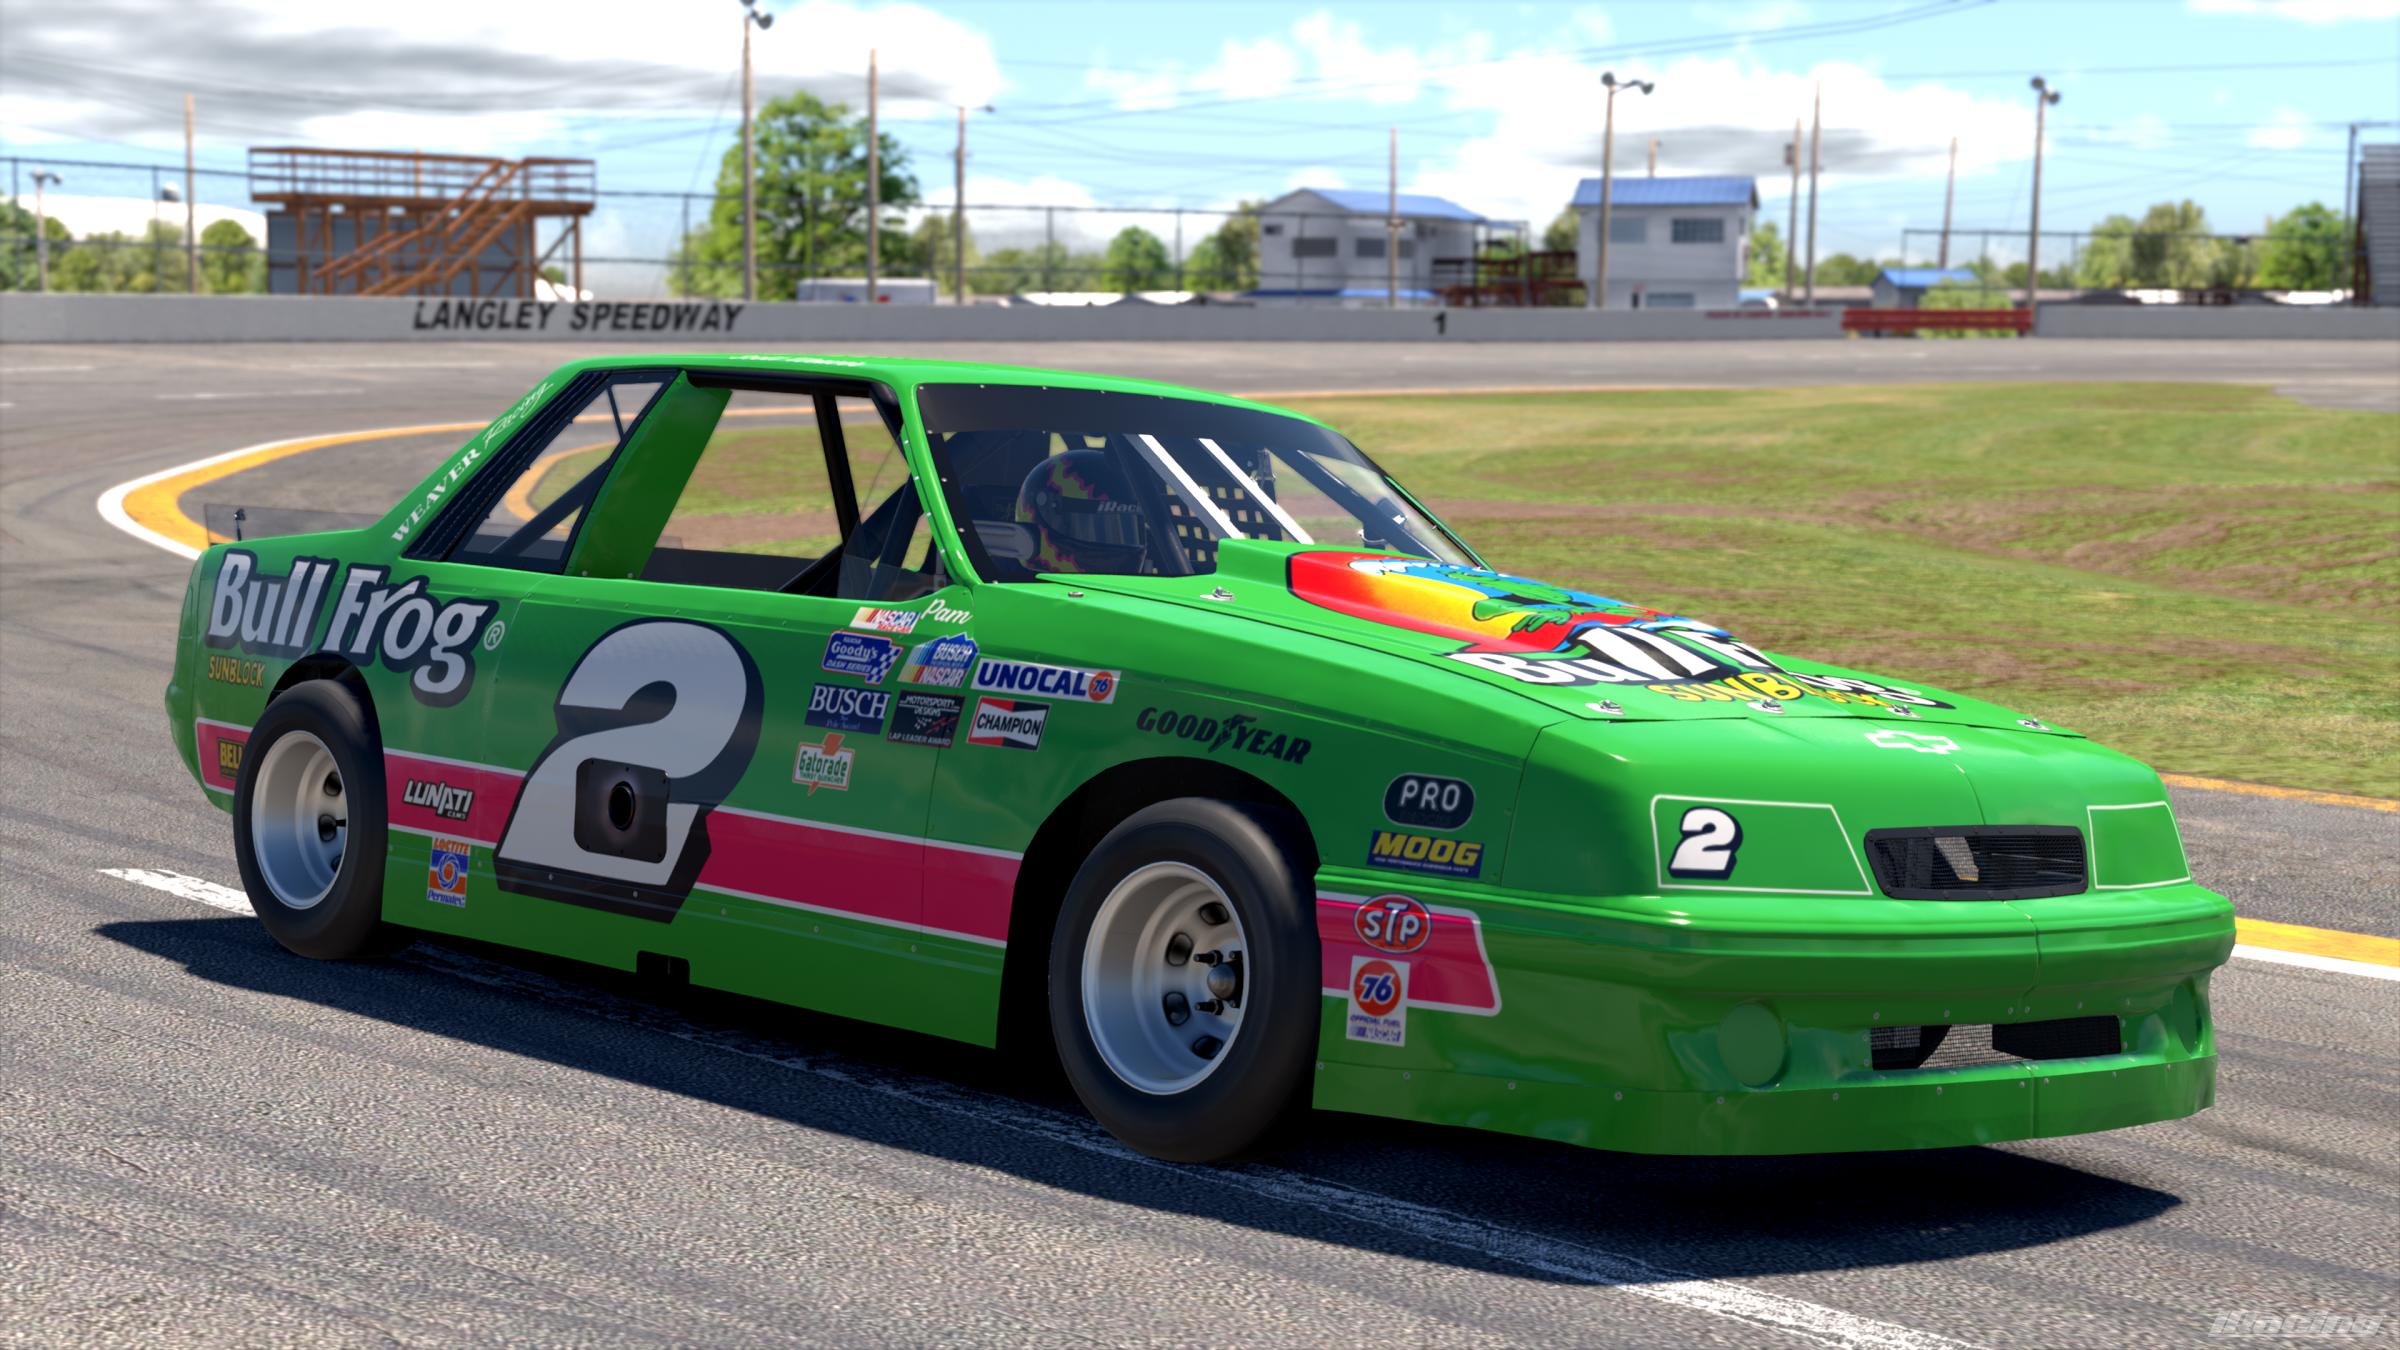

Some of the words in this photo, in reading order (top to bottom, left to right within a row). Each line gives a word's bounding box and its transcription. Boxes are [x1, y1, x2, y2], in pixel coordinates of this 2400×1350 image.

[413, 301, 556, 330] LANGLEY
[569, 302, 744, 332] SPEEDWAY
[1433, 311, 1447, 336] 1
[391, 448, 481, 541] WEAVER
[207, 551, 334, 650] Bull
[319, 566, 490, 695] Frog
[873, 608, 918, 628] NASCAR
[919, 598, 974, 625] Pam
[830, 640, 880, 663] Goody's
[932, 642, 973, 664] BUSCH
[207, 655, 266, 689] SUNBLOCK
[919, 665, 967, 689] NASCAR
[977, 662, 1087, 697] UNOCAL
[1092, 677, 1110, 694] 76
[808, 684, 892, 719] BUSCH
[976, 712, 1044, 737] CHAMPION
[1135, 706, 1313, 765] GOODYEAR
[495, 618, 752, 890] 2
[799, 750, 849, 777] Gatorade
[403, 779, 474, 815] LUNATI
[1399, 779, 1461, 812] PRO
[433, 837, 471, 855] LOCTITE
[1371, 831, 1482, 867] MOOG
[1669, 807, 1739, 874] 2
[1362, 901, 1421, 945] STP
[1359, 973, 1395, 1005] 76
